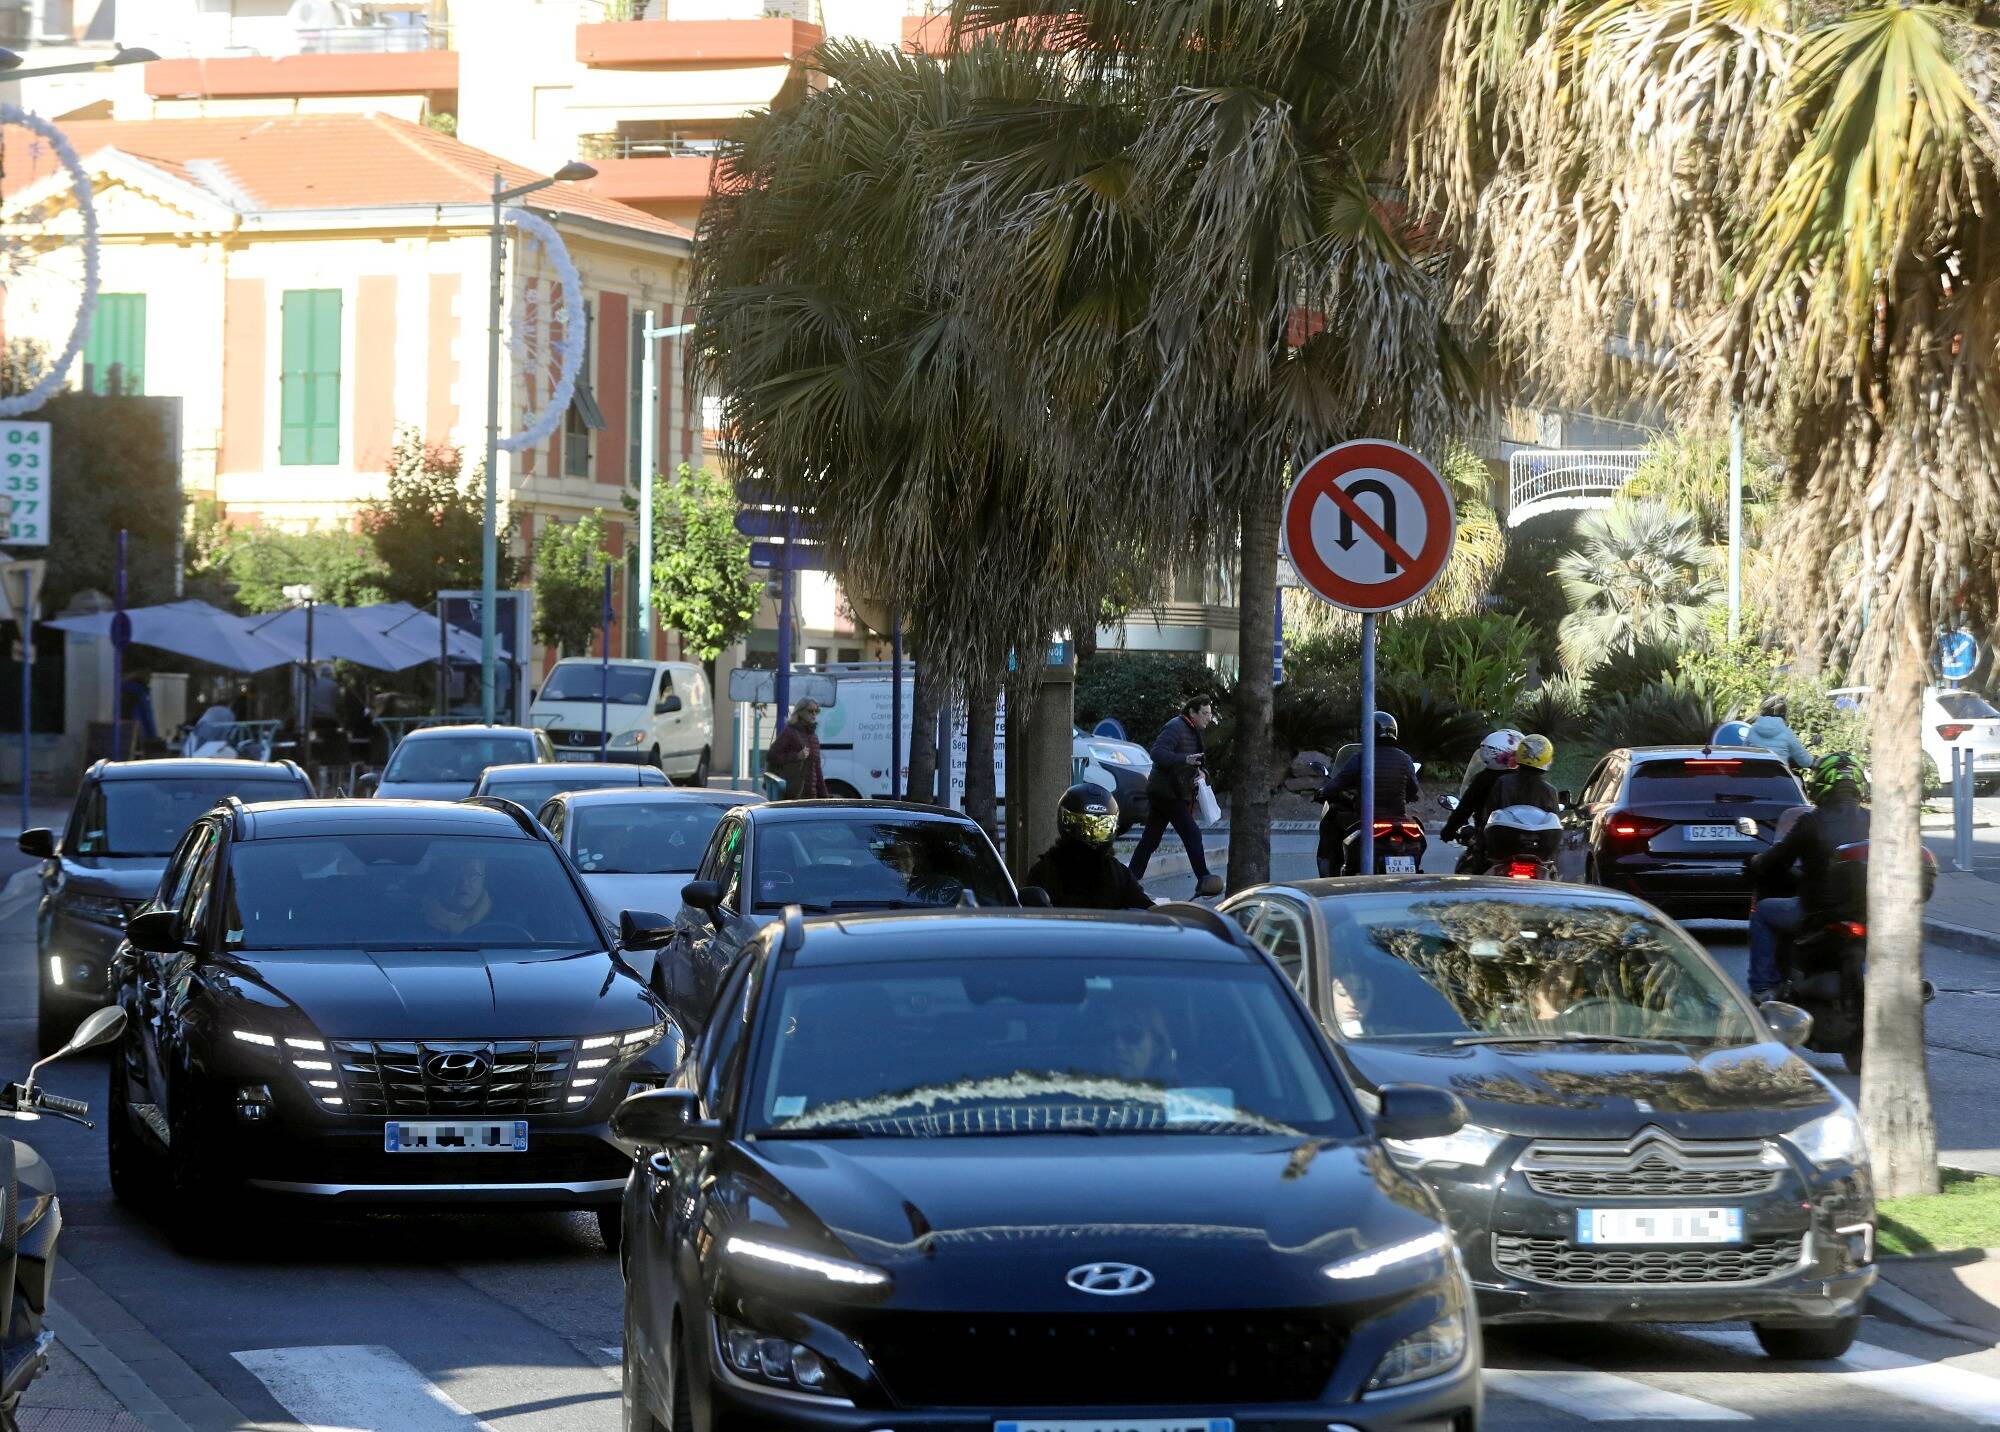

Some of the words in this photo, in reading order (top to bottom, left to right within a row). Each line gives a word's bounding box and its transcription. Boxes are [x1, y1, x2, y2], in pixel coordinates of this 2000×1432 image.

[7, 430, 39, 445] 04
[7, 453, 39, 468] 93
[7, 476, 39, 492] 35
[11, 500, 38, 514] 77
[10, 523, 37, 538] 12
[514, 1137, 526, 1148] 06
